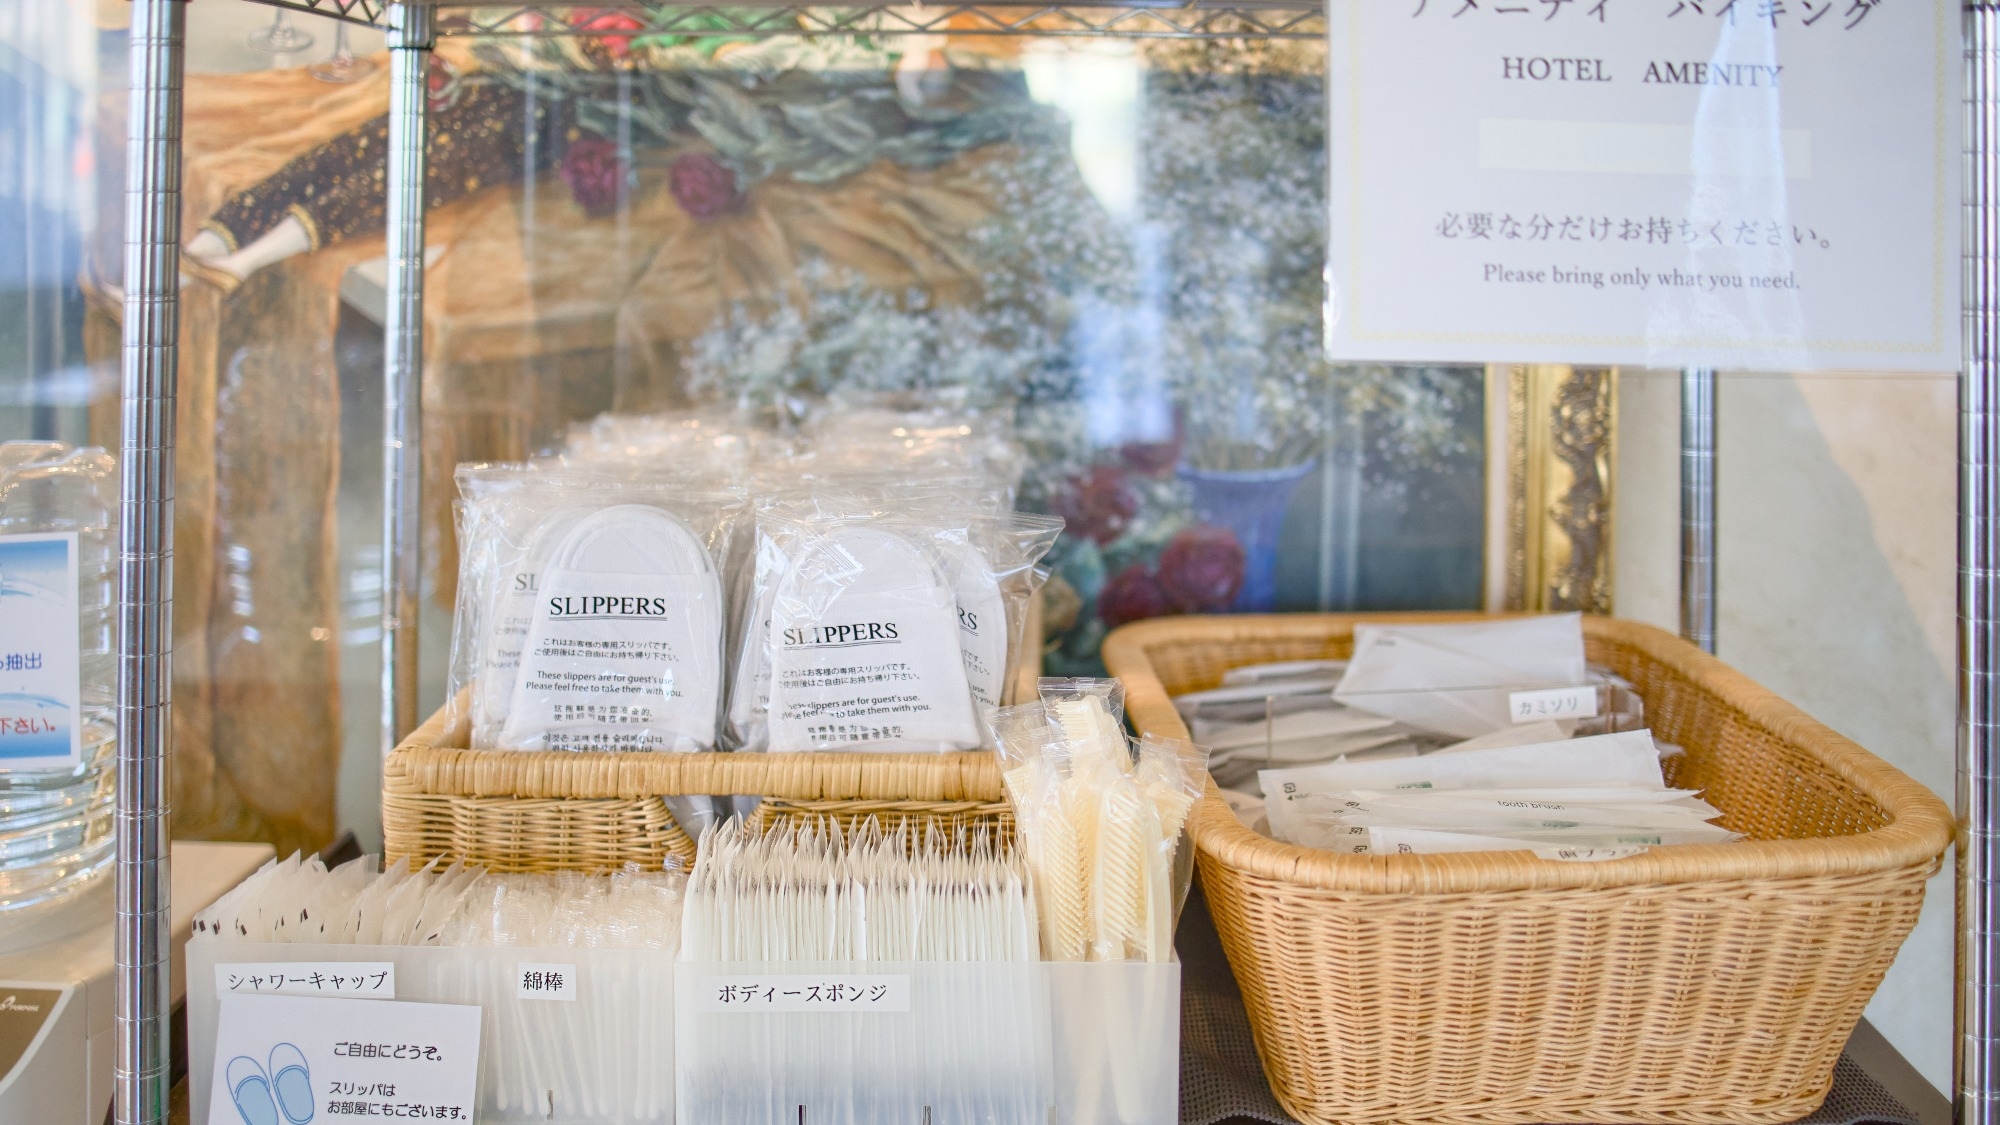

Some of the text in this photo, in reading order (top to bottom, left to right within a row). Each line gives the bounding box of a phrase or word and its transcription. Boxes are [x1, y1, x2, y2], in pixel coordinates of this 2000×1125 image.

[1502, 57, 1784, 87] HOTEL AMENITY
[1435, 212, 1832, 249] 必要な分だけお持ちください。
[1483, 263, 1801, 291] Please bring only what you need.
[550, 596, 666, 616] SLIPPERS
[783, 622, 899, 645] SLIPPERS
[526, 681, 552, 691] Please
[554, 682, 570, 692] feel
[571, 683, 588, 692] free
[590, 685, 600, 693] to
[601, 684, 620, 694] take
[622, 685, 643, 694] them
[537, 670, 561, 680] These
[563, 671, 596, 683] slippers
[598, 674, 612, 682] are
[613, 673, 627, 682] for
[628, 674, 657, 685] guest's
[841, 699, 856, 707] are
[857, 697, 870, 705] for
[871, 695, 902, 706] guest's
[903, 695, 920, 703] use.
[847, 708, 866, 717] take
[867, 706, 890, 715] them
[891, 704, 911, 713] with
[912, 704, 932, 713] you.
[1518, 695, 1579, 716] カミソリ
[228, 970, 388, 990] シャワーキャップ
[523, 971, 564, 992] 綿棒
[718, 983, 888, 1003] ボディースポンジ
[333, 1041, 443, 1061] ご自由にどうぞ。
[329, 1081, 396, 1097] スリッパは
[327, 1100, 467, 1120] お部屋にもございます。
